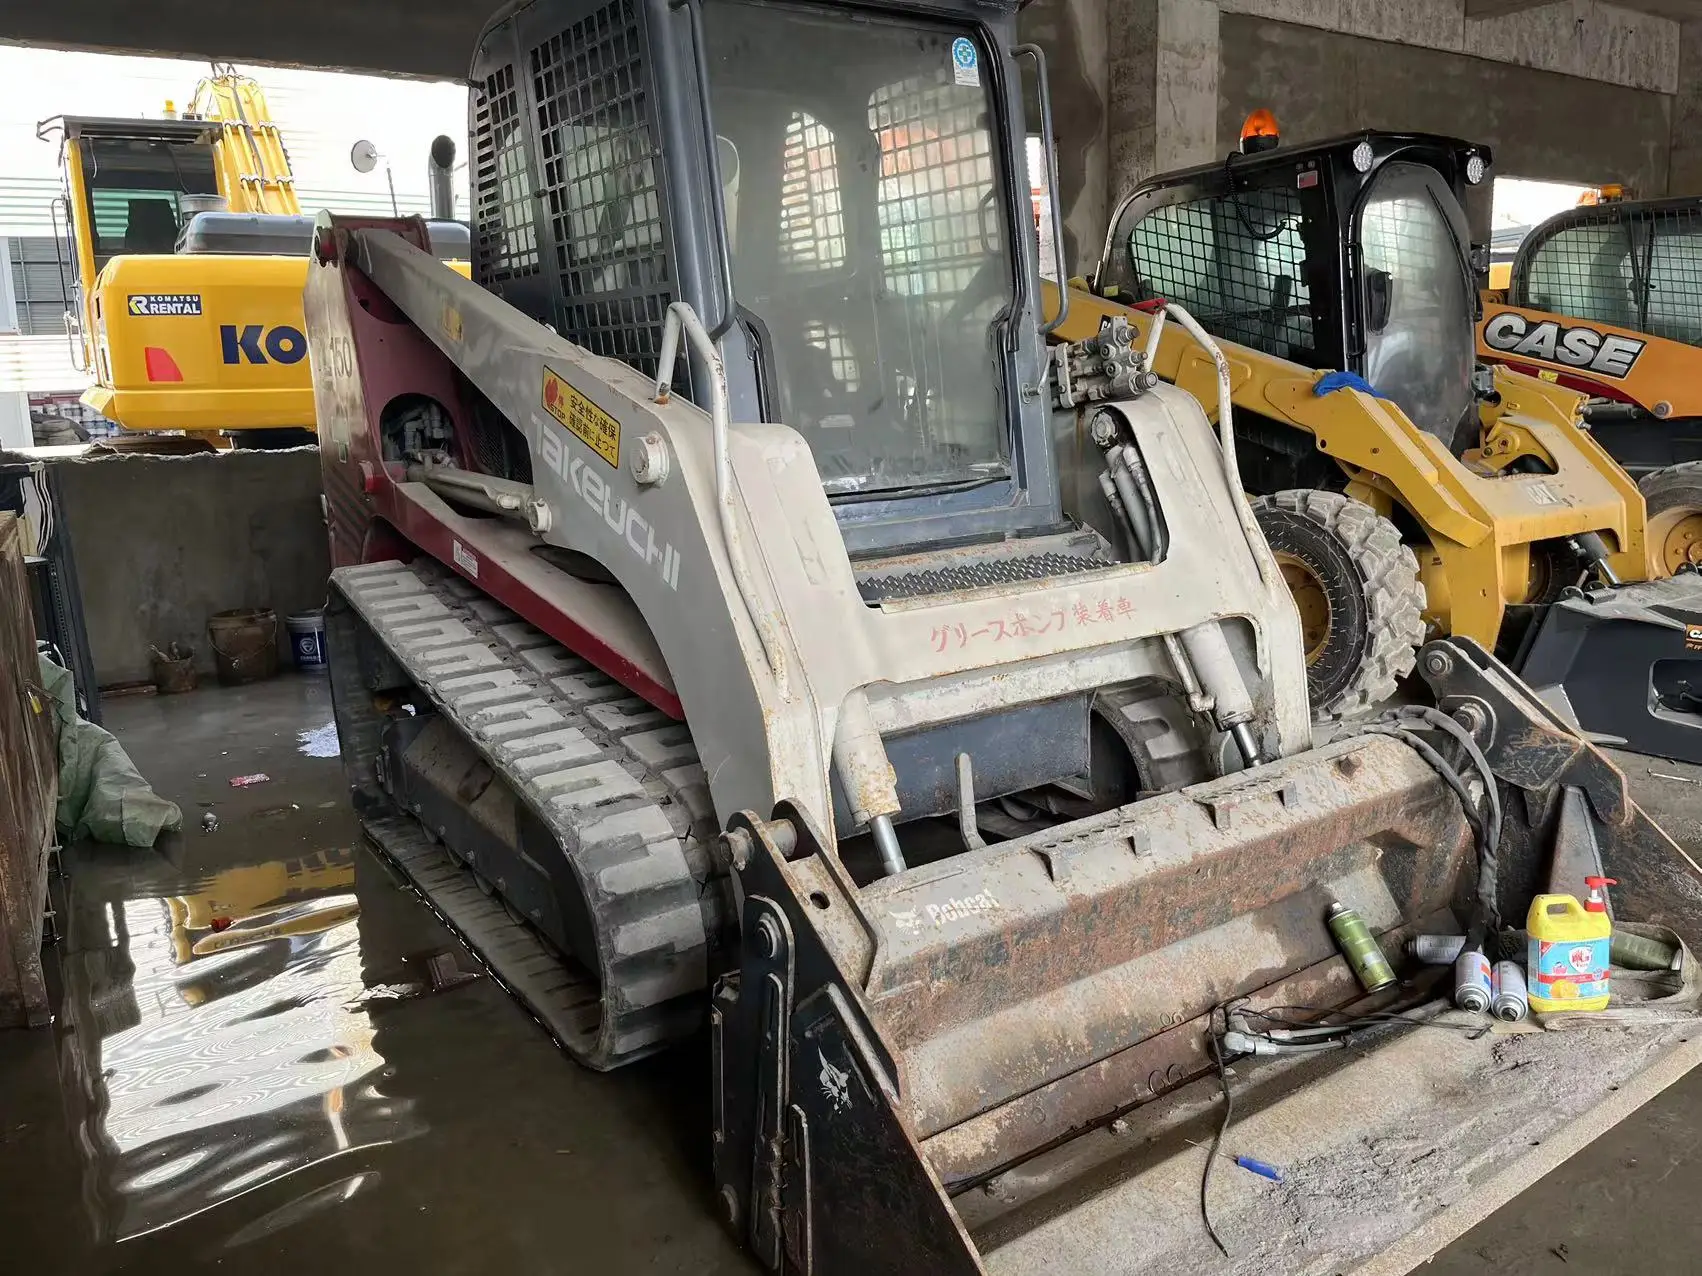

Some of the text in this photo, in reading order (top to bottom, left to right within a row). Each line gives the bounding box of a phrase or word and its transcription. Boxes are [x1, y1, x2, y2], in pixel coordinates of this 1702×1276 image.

[151, 303, 200, 314] RENTAL
[1485, 312, 1645, 377] CASE
[550, 405, 566, 420] STOP
[925, 888, 1000, 925] Bobcat
